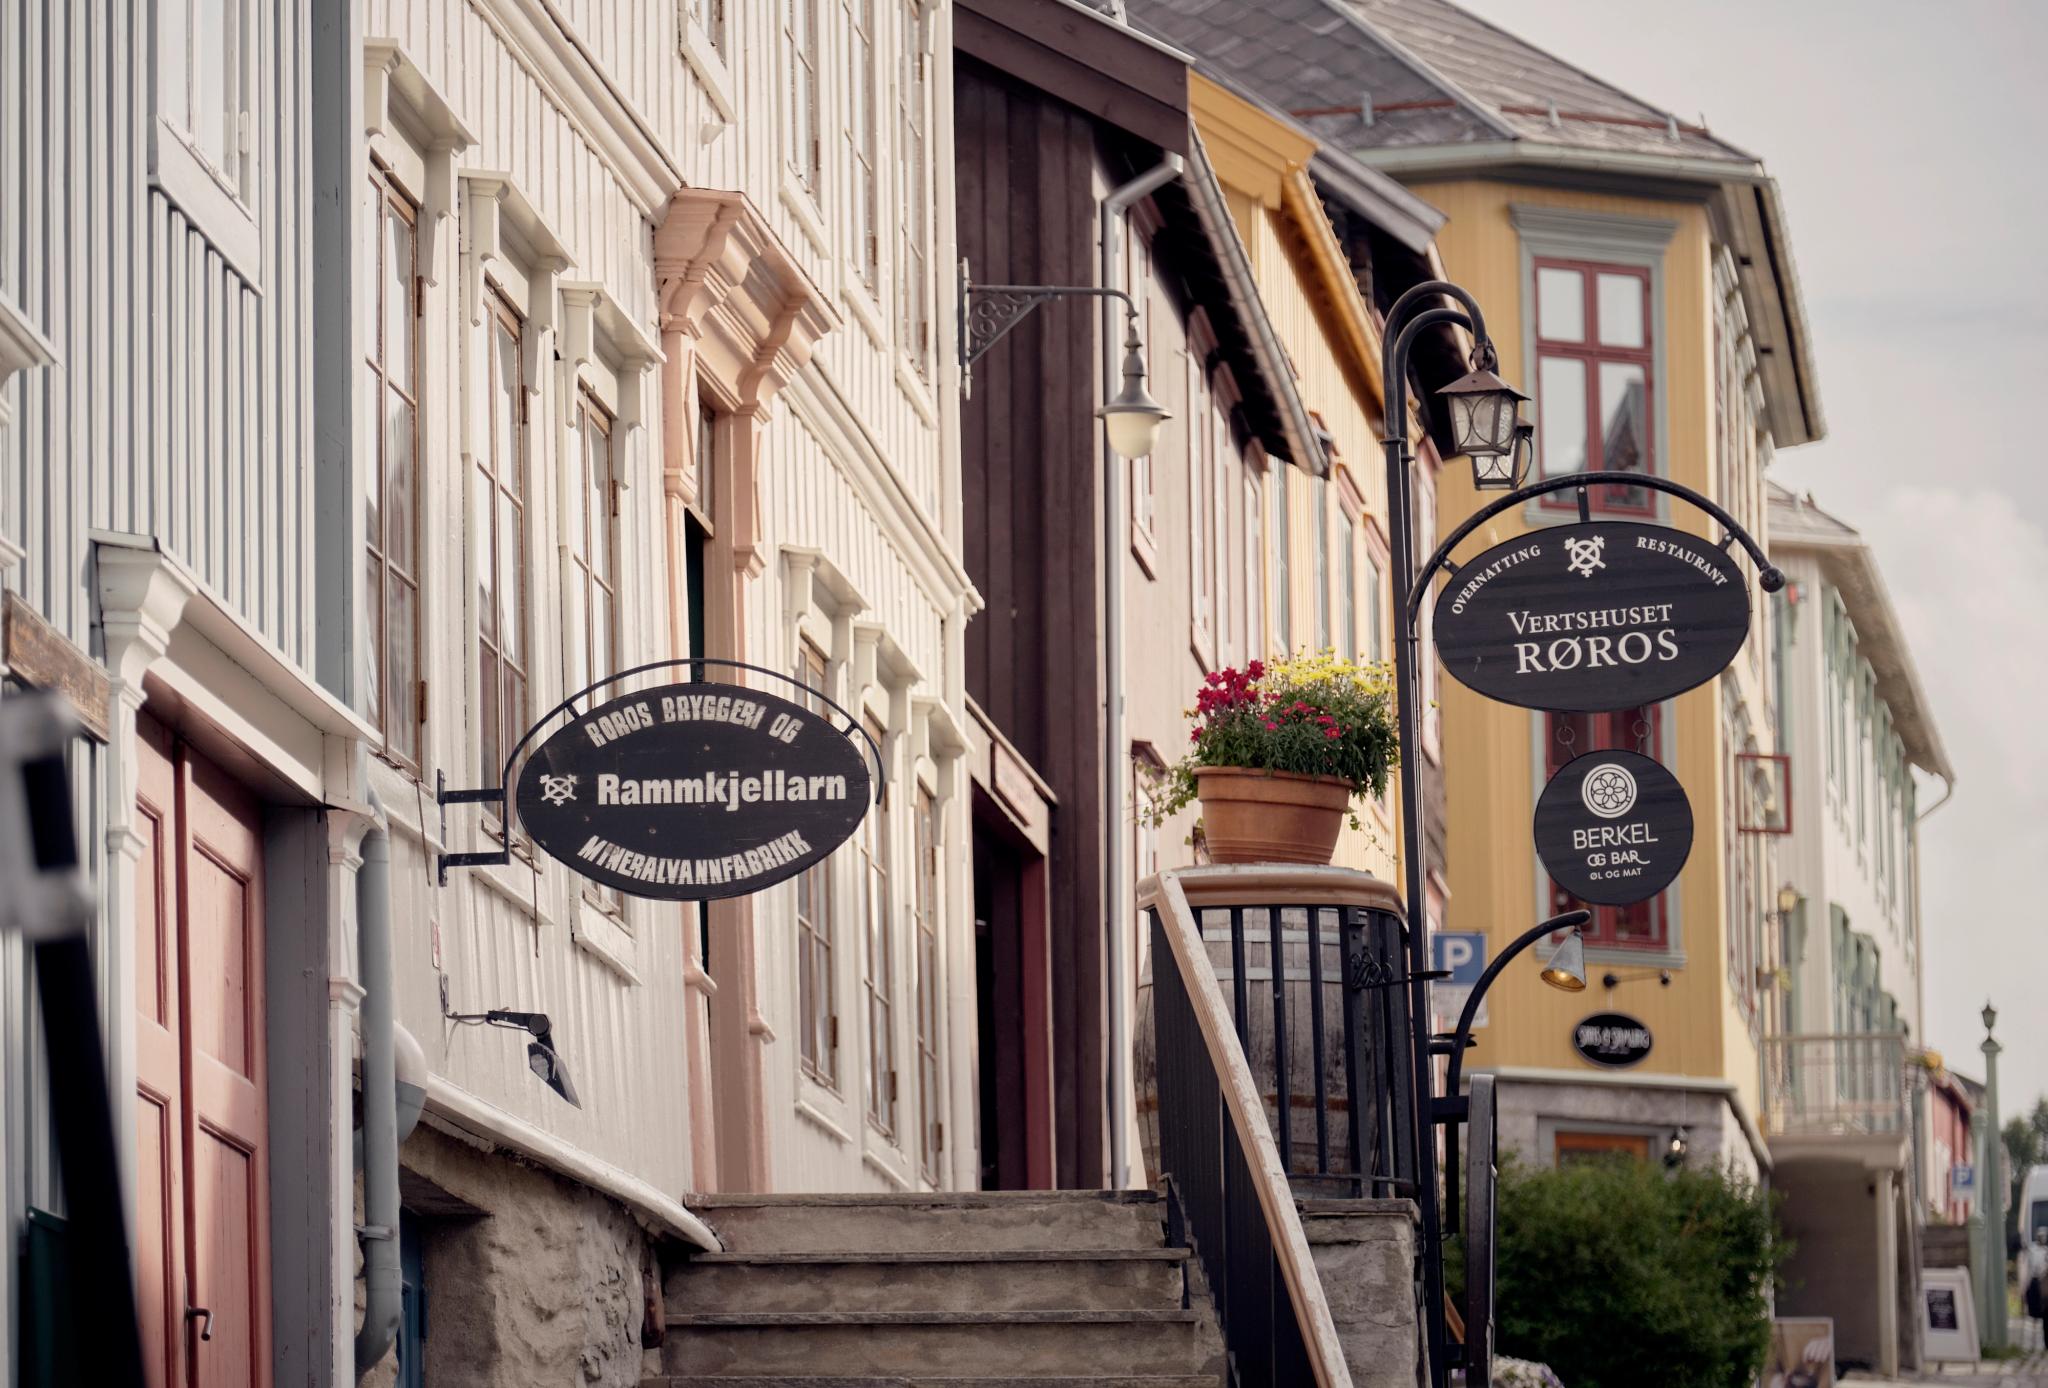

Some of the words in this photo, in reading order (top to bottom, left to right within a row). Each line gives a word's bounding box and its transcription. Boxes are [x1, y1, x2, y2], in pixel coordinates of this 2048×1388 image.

[1452, 544, 1541, 615] OVERNATTING
[1637, 536, 1729, 587] RESTAURANT
[1506, 603, 1674, 637] VERTSHUSET
[1514, 628, 1679, 673] RØROS
[661, 695, 767, 730] BRYGGERI
[768, 713, 804, 744] OG
[598, 770, 846, 811] Rammkjellarn
[577, 829, 812, 885] MINERALVANNFABRIKK
[1573, 823, 1659, 850] BERKEL
[1587, 853, 1607, 867] OG
[1611, 850, 1650, 865] BAR
[1605, 870, 1620, 879] OG
[1623, 868, 1642, 877] MAT
[1443, 936, 1473, 981] P
